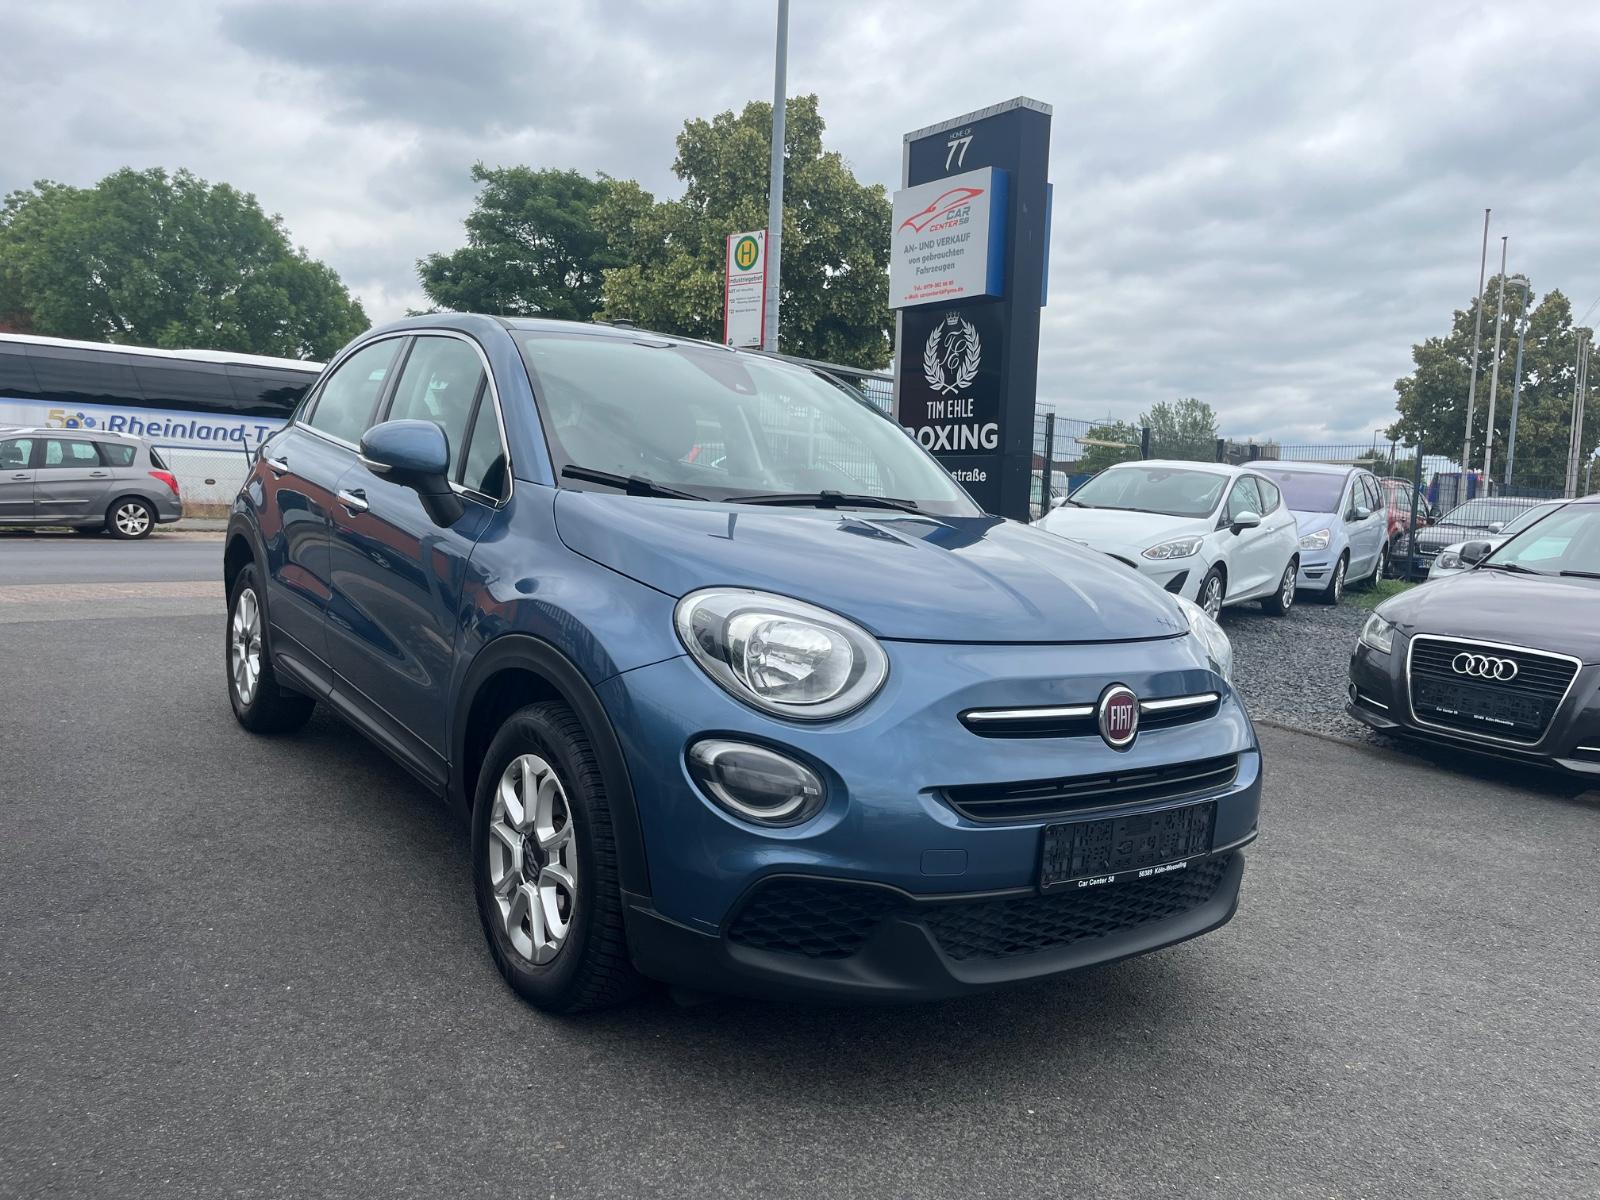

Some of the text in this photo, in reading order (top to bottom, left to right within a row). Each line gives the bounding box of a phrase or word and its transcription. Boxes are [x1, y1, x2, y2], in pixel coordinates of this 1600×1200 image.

[945, 135, 973, 171] 77
[946, 206, 971, 221] CAR
[929, 219, 958, 232] CENTER
[758, 232, 763, 240] A
[903, 232, 971, 254] AN- UND VERKAUF
[741, 242, 752, 263] H
[908, 247, 965, 264] von gebrauchten
[915, 262, 956, 276] Fahrzeugen
[926, 398, 974, 419] TIM EHLE
[1110, 704, 1132, 731] FIAT
